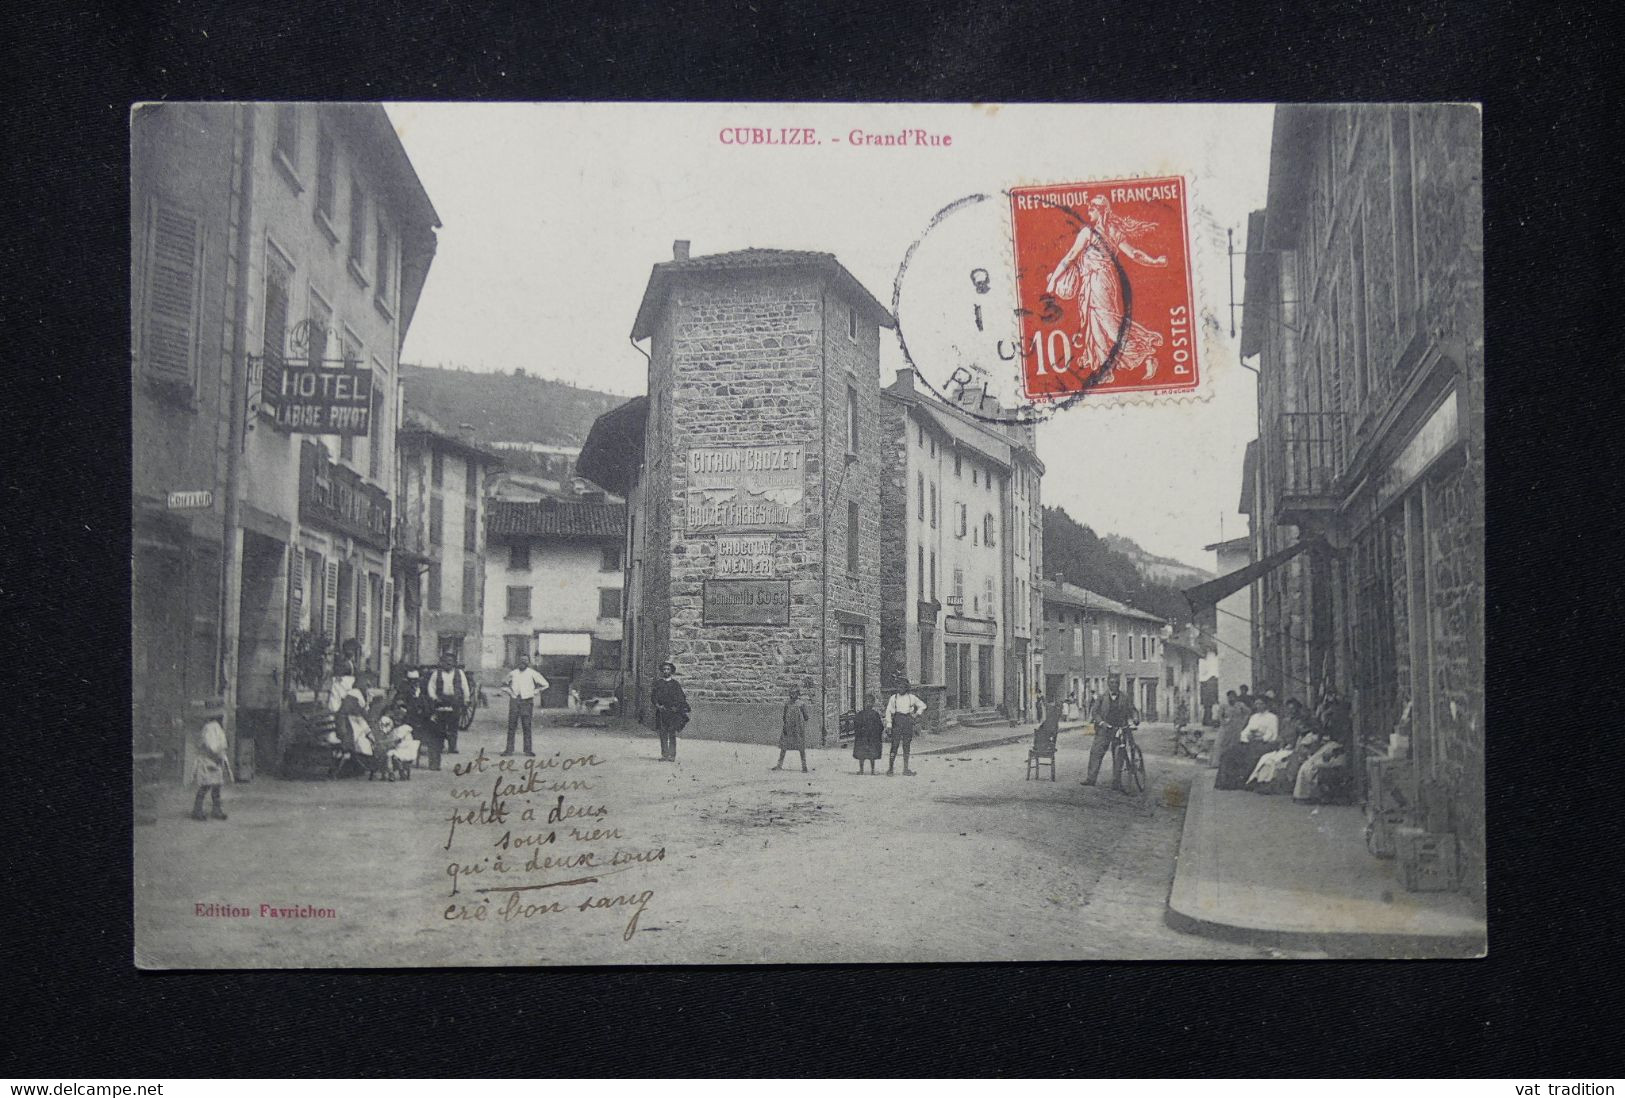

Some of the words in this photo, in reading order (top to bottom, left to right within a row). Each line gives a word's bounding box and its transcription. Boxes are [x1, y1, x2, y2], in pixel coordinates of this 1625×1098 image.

[719, 127, 822, 145] CUBLIZE.
[849, 128, 952, 146] Grand'Rue
[1111, 184, 1178, 203] FRANÇAISE
[1170, 305, 1190, 375] POSTES
[282, 369, 368, 400] HOTEL
[688, 504, 729, 527] CROZET
[719, 540, 772, 556] CHOCOLAT
[721, 558, 771, 574] MENIER
[491, 772, 547, 818] fait
[549, 778, 593, 793] un
[444, 801, 510, 850] petit
[548, 795, 609, 824] deux
[494, 831, 555, 850] sous
[569, 826, 622, 842] rien
[525, 848, 600, 871] deux
[611, 847, 666, 866] sous
[194, 903, 250, 918] Edition
[259, 903, 337, 919] Favrichon
[498, 891, 566, 922] bon
[579, 890, 655, 942] sang
